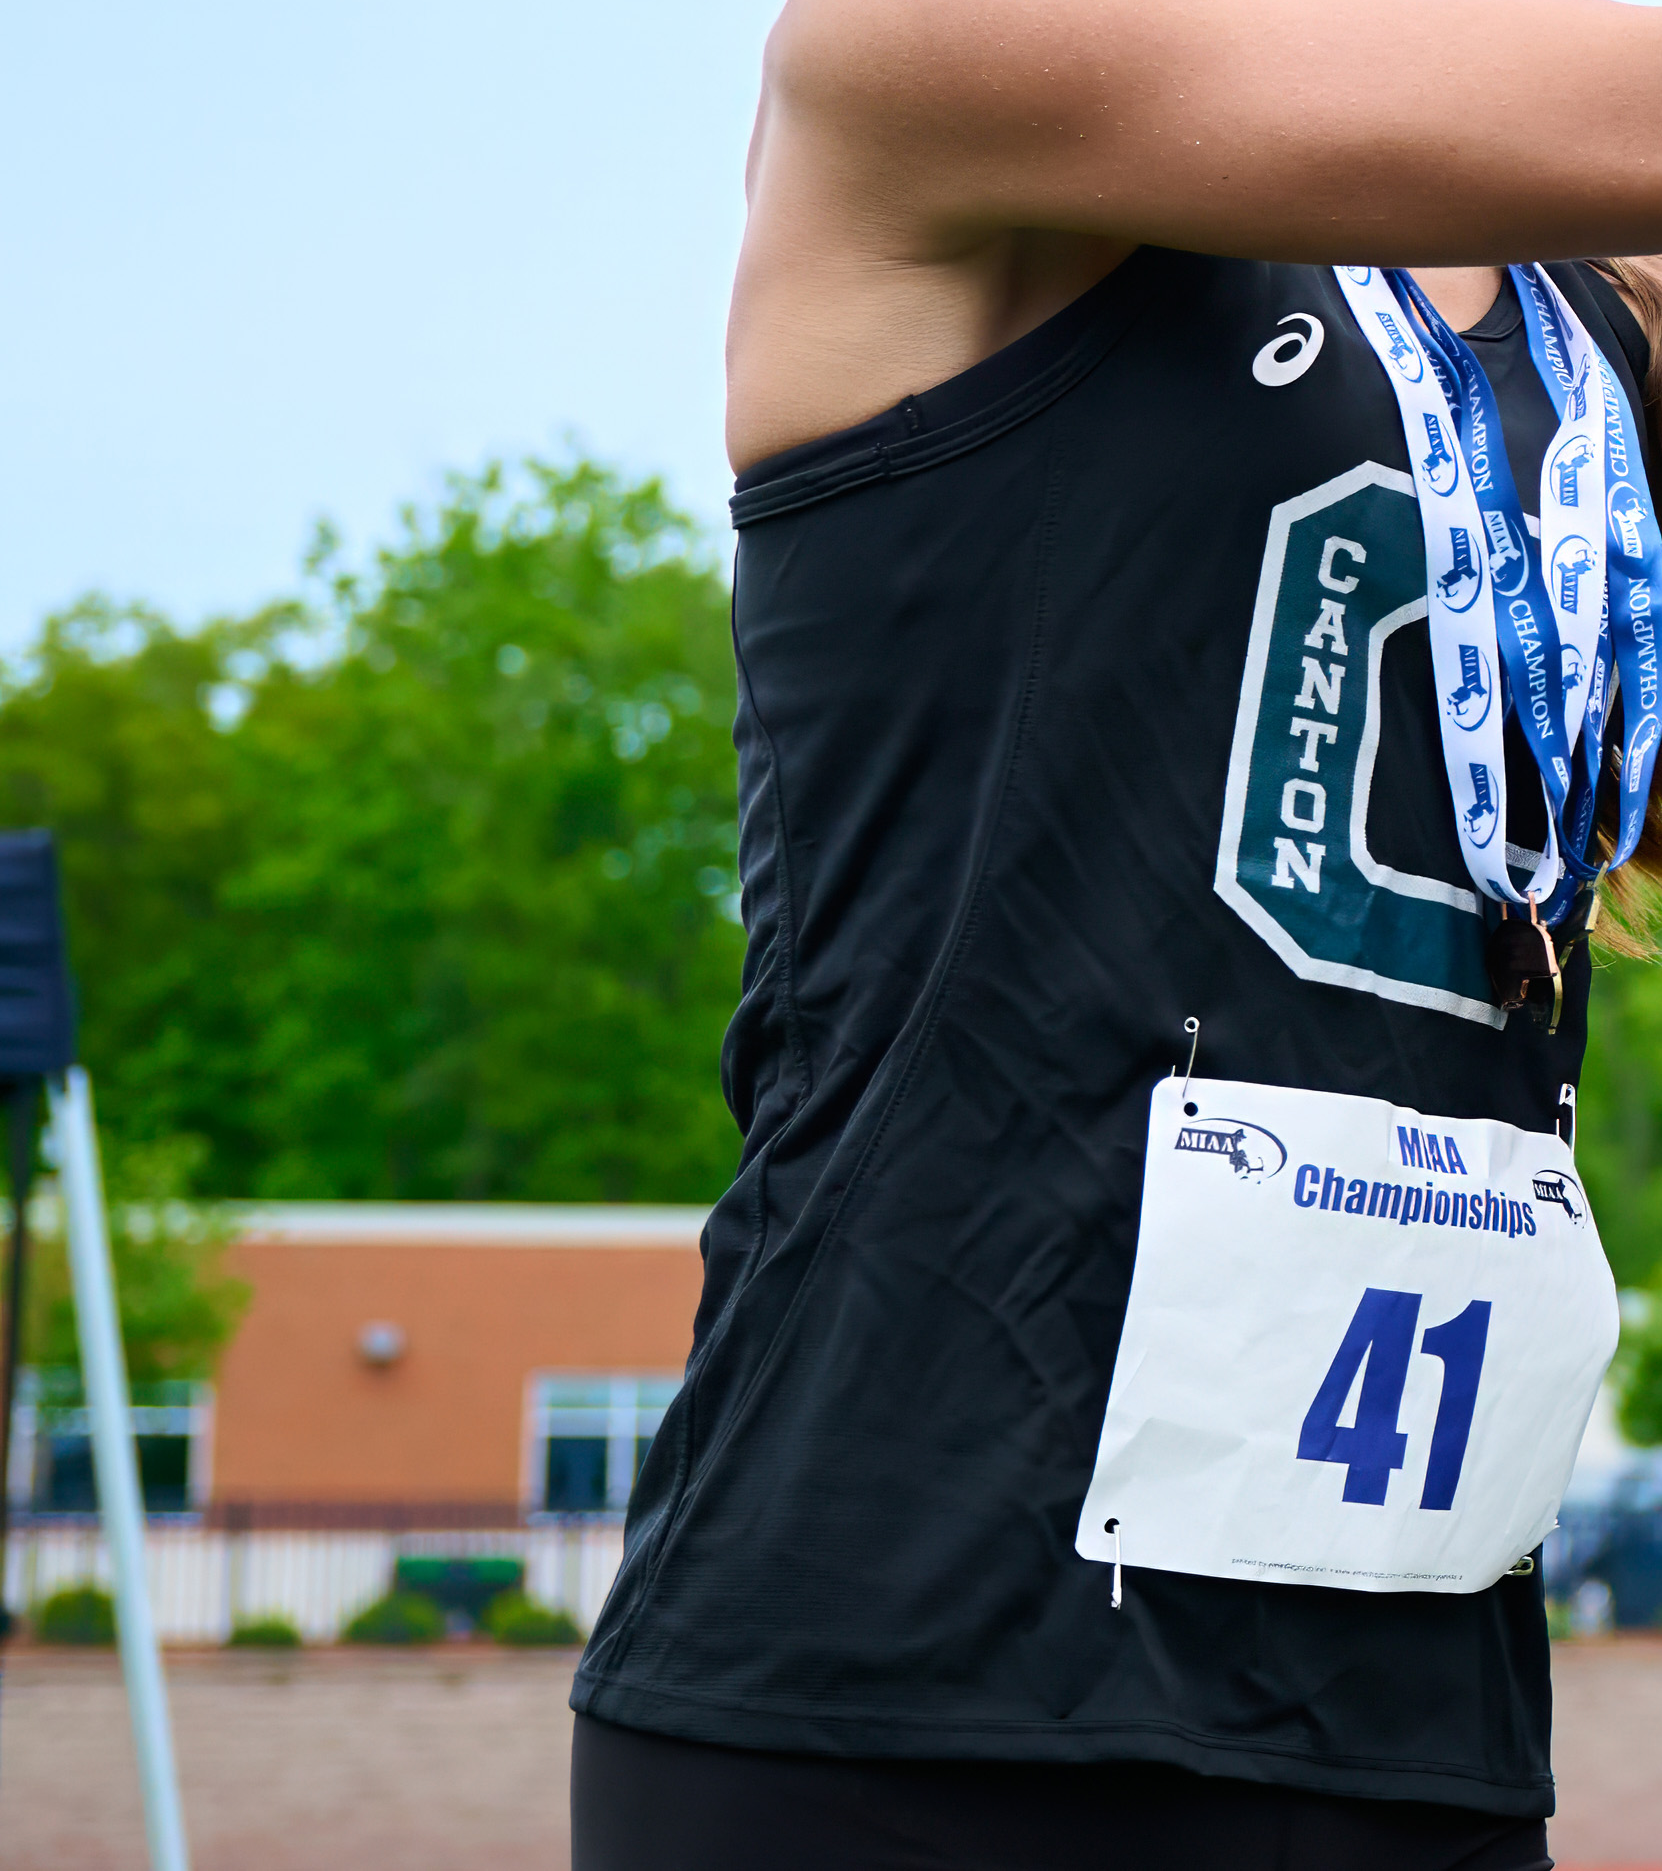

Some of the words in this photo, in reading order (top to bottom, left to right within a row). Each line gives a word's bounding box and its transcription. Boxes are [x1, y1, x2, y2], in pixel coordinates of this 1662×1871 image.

[1530, 287, 1575, 392] CHAMPIO
[1508, 600, 1554, 740] CHAMPION
[1629, 577, 1659, 710] CHAMPION
[1271, 535, 1367, 894] CANTON
[1179, 1130, 1235, 1153] MIAA
[1396, 1125, 1468, 1176] MIAA
[1534, 1183, 1564, 1200] MIAA
[1293, 1163, 1537, 1239] Championships
[1295, 1287, 1493, 1511] 41
